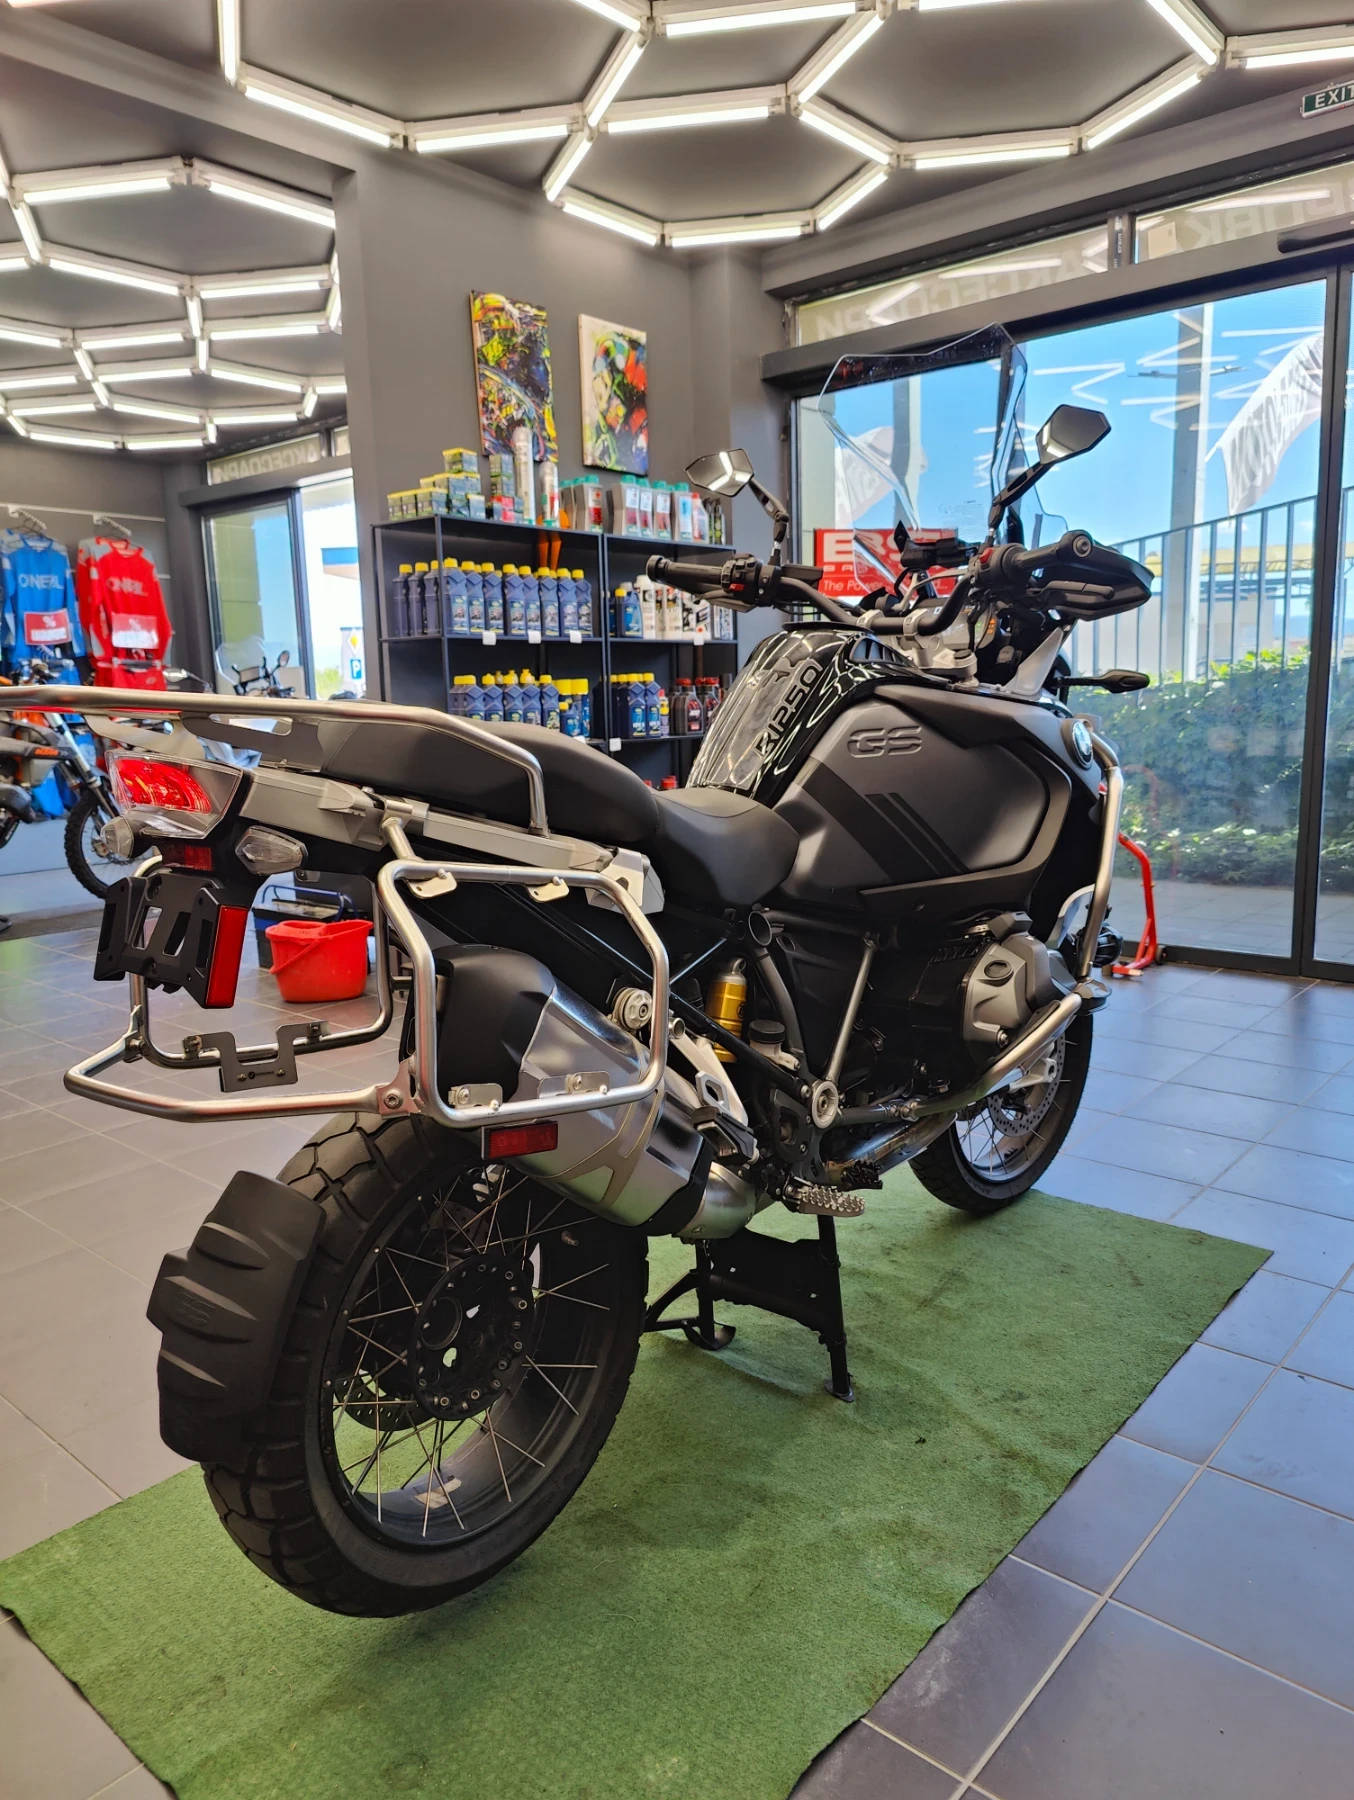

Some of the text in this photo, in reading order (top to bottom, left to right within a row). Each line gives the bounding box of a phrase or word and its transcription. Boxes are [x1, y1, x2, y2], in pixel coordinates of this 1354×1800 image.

[1315, 85, 1354, 108] EXIT
[823, 580, 844, 591] The
[848, 726, 923, 758] GS
